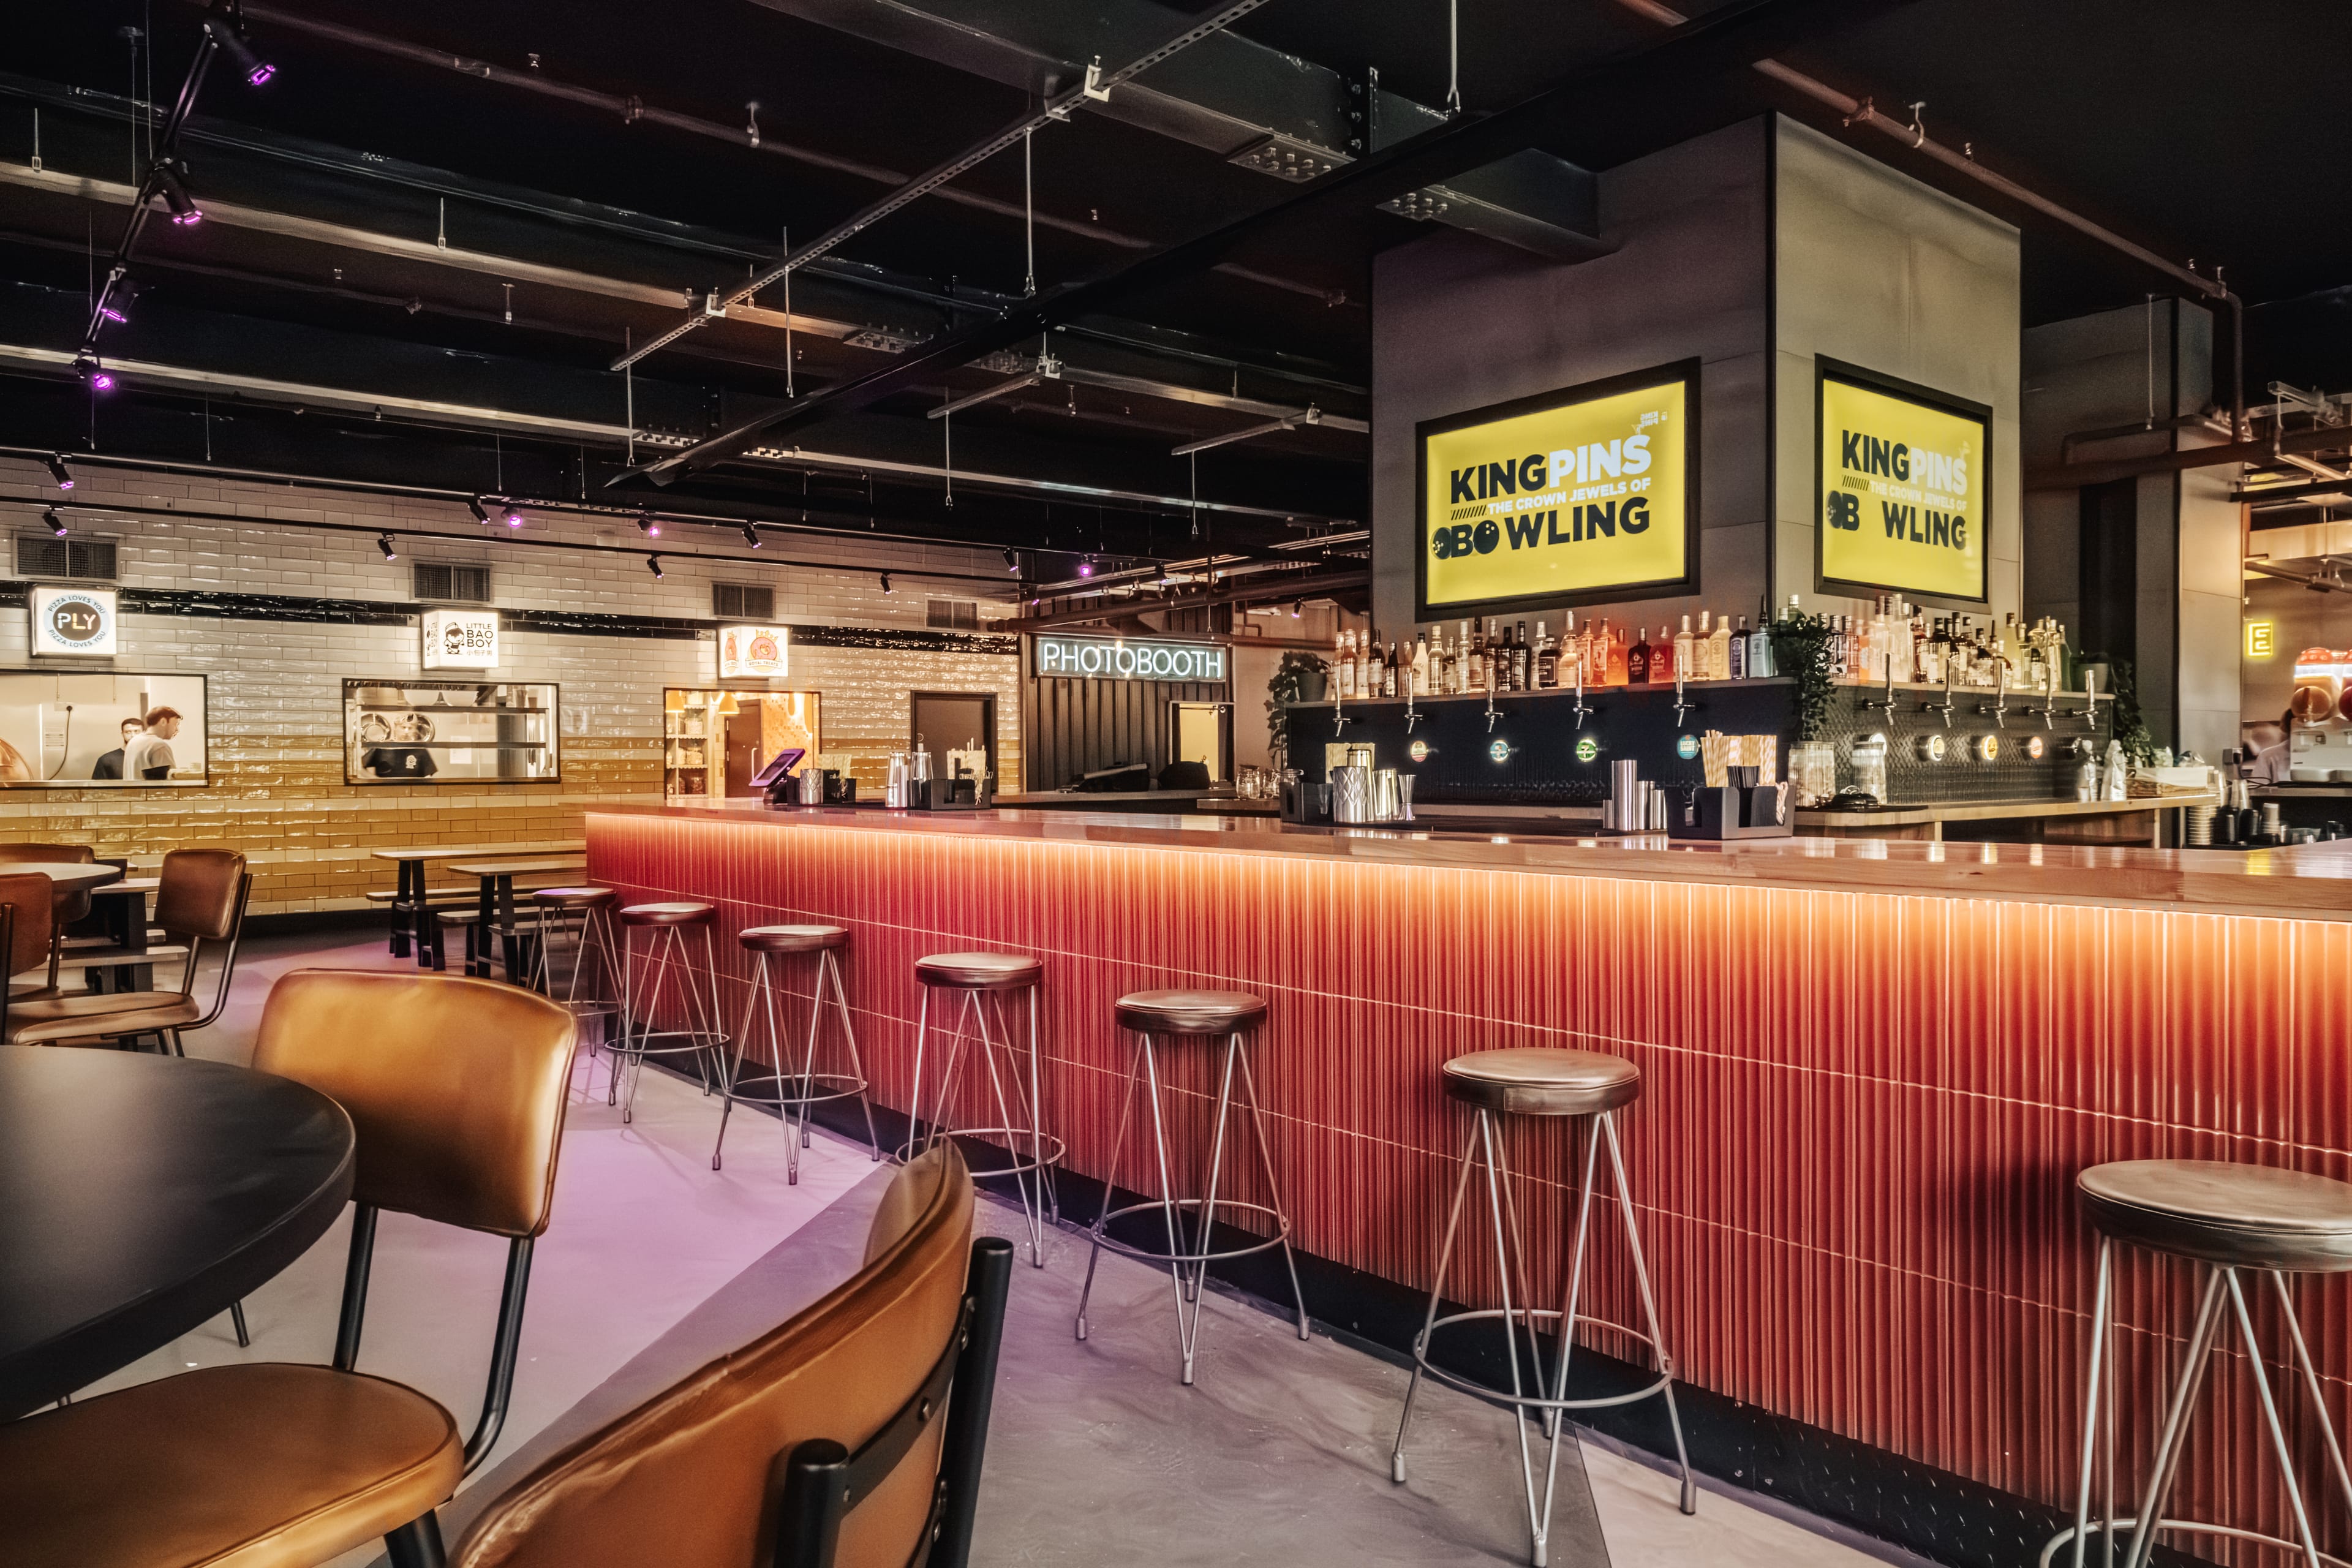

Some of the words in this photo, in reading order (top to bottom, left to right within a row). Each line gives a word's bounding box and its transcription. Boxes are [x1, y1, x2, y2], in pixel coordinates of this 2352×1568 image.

[1451, 434, 1651, 504] KINGPINS
[1842, 429, 1967, 496] KINGPINS
[1488, 500, 1513, 515] THE
[1516, 488, 1567, 511] CROWN
[1569, 481, 1627, 503] JEWELS
[1630, 477, 1651, 492] OF
[1870, 480, 1889, 497] THE
[1889, 484, 1923, 503] CROWN
[1923, 491, 1955, 510] JEWELS
[1956, 500, 1967, 512] OF
[48, 597, 66, 612] PIZZA
[69, 595, 91, 603] LOVES
[92, 602, 105, 614] YOU
[57, 612, 96, 630] PLY
[49, 629, 66, 645] PIZZA
[93, 631, 106, 643] YOU
[467, 630, 494, 638] BAO
[467, 639, 492, 647] BOY
[1043, 643, 1221, 677] PHOTOBOOTH
